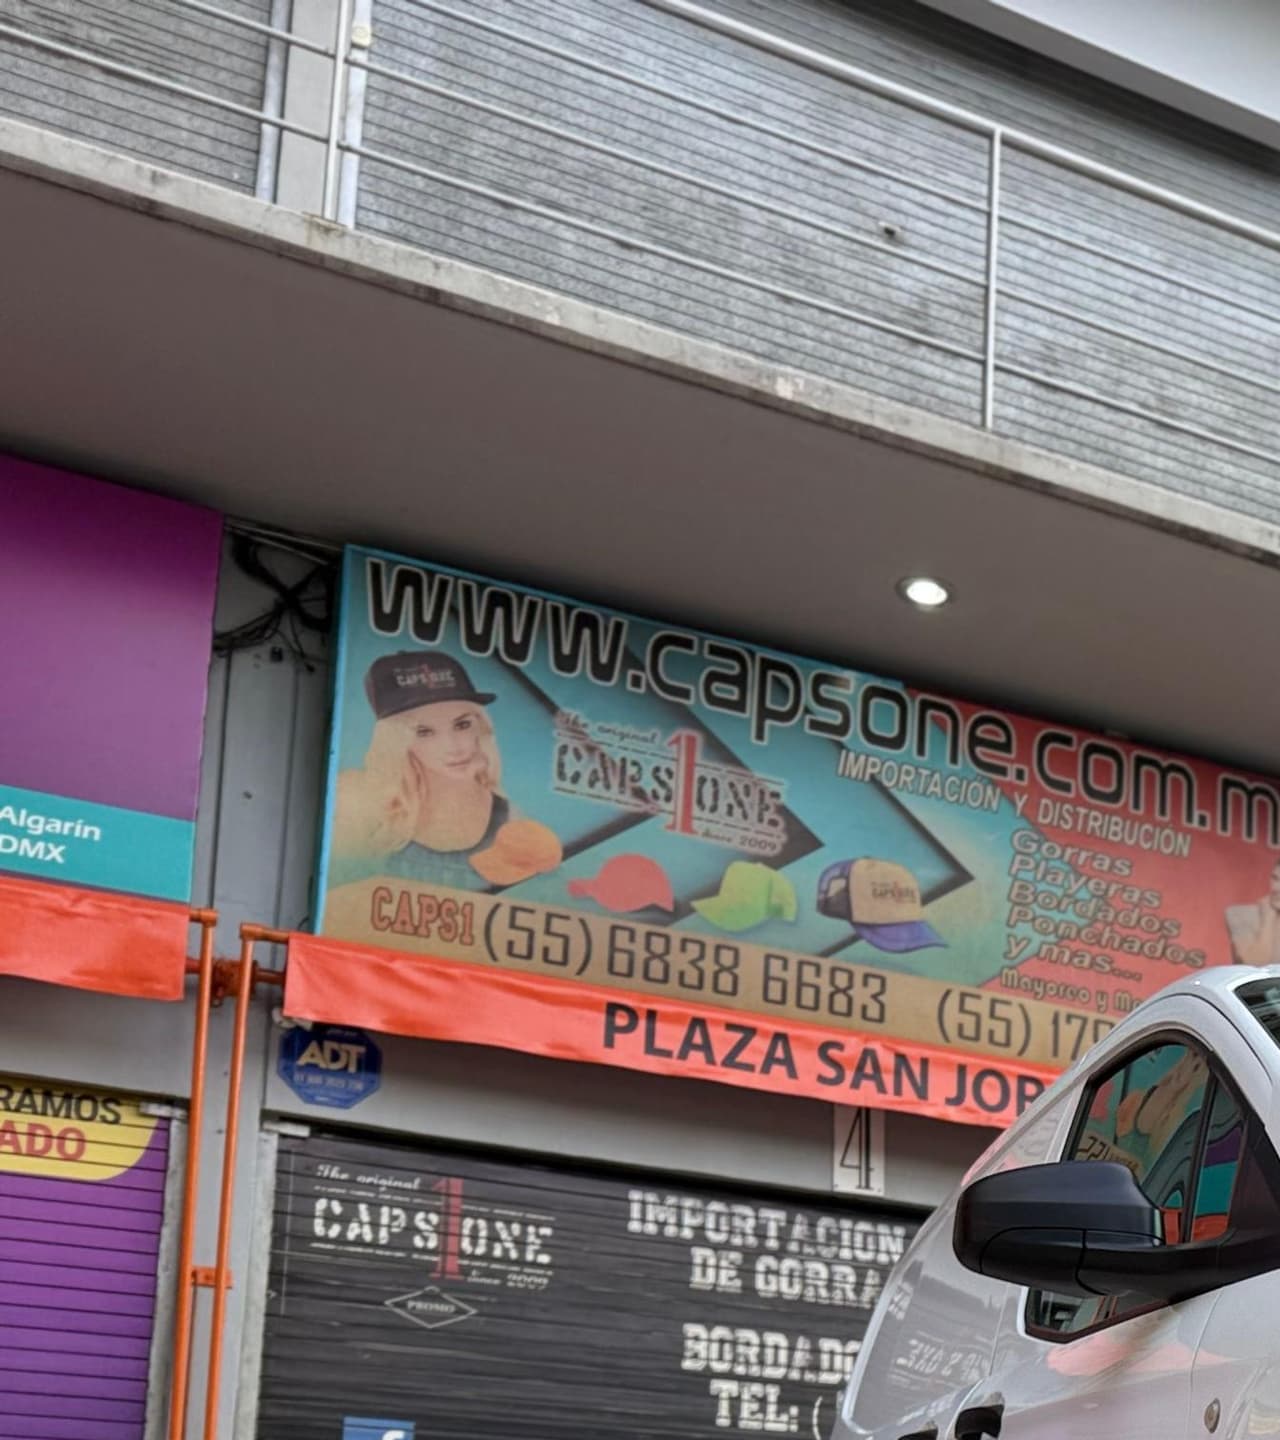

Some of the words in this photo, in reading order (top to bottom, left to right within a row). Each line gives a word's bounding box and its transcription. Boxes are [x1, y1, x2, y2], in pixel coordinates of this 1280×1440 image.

[0, 805, 101, 841] Algarín
[838, 749, 1002, 813] IMPORTACIÓN
[1013, 791, 1028, 817] Y
[1037, 797, 1192, 857] DISTRIBUCIÓN
[1012, 829, 1133, 877] Gorras
[1008, 879, 1182, 938] Bordados
[1009, 854, 1162, 910] Playeras
[1004, 933, 1030, 961] y
[1006, 904, 1207, 969] Ponchados
[370, 885, 474, 946] CAPS1
[484, 902, 593, 976] (55)
[606, 924, 741, 997] 6838
[763, 953, 887, 1025] 6683
[937, 987, 1032, 1057] (55)
[296, 1040, 367, 1074] ADT
[602, 1002, 799, 1081] PLAZA
[817, 1039, 930, 1102] SAN
[0, 1084, 122, 1125] RAMOS
[0, 1120, 86, 1162] ADO
[627, 1189, 907, 1266] IMPORTACION
[689, 1246, 744, 1294] DE
[709, 1378, 800, 1433] TEL:
